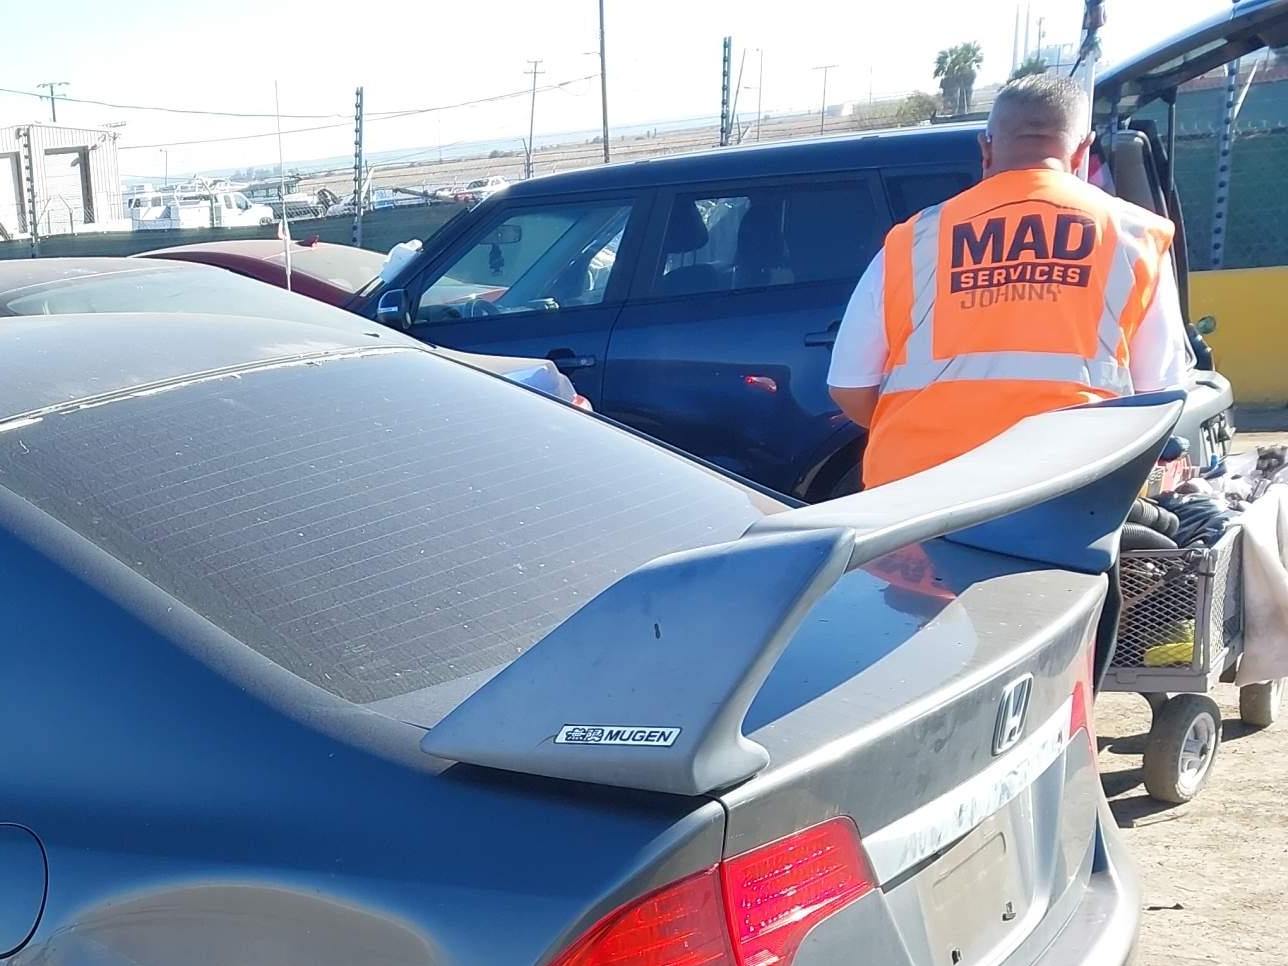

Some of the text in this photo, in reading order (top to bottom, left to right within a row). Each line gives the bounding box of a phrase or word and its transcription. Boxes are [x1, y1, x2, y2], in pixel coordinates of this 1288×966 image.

[951, 213, 1097, 269] MAD
[959, 265, 1081, 289] SERVICES
[959, 284, 1062, 310] JOHNNY
[599, 728, 674, 743] MUGEN
